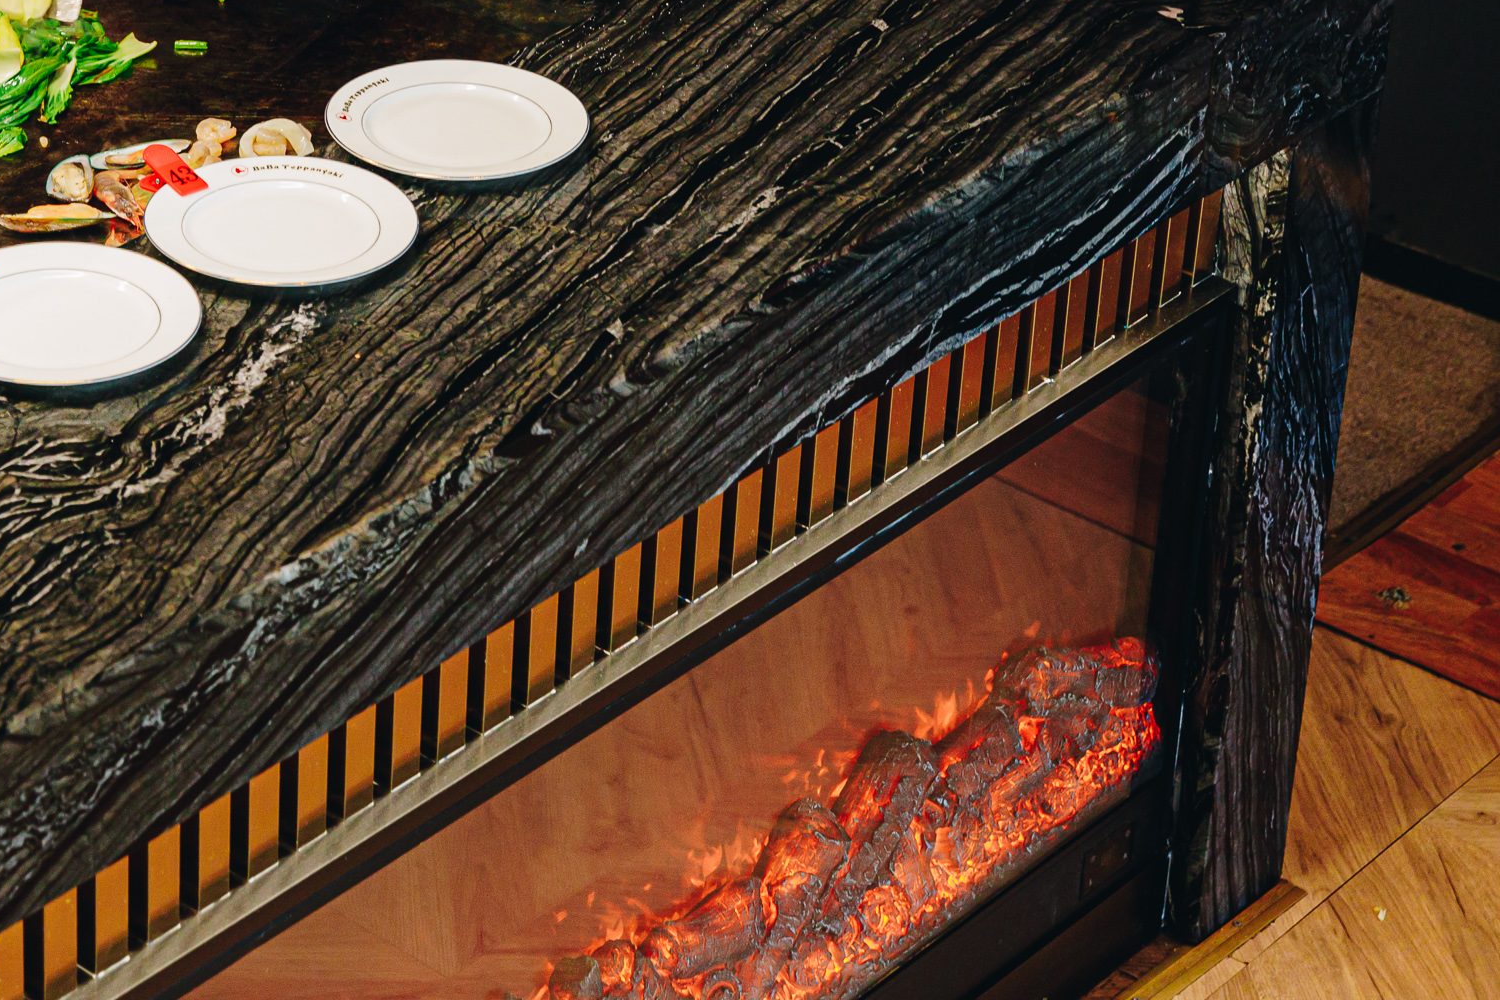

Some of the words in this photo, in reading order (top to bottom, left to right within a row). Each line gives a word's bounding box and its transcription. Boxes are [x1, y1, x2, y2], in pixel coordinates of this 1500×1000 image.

[169, 165, 199, 187] 43
[252, 164, 280, 172] BaBa
[282, 164, 344, 178] Teppanyaki
